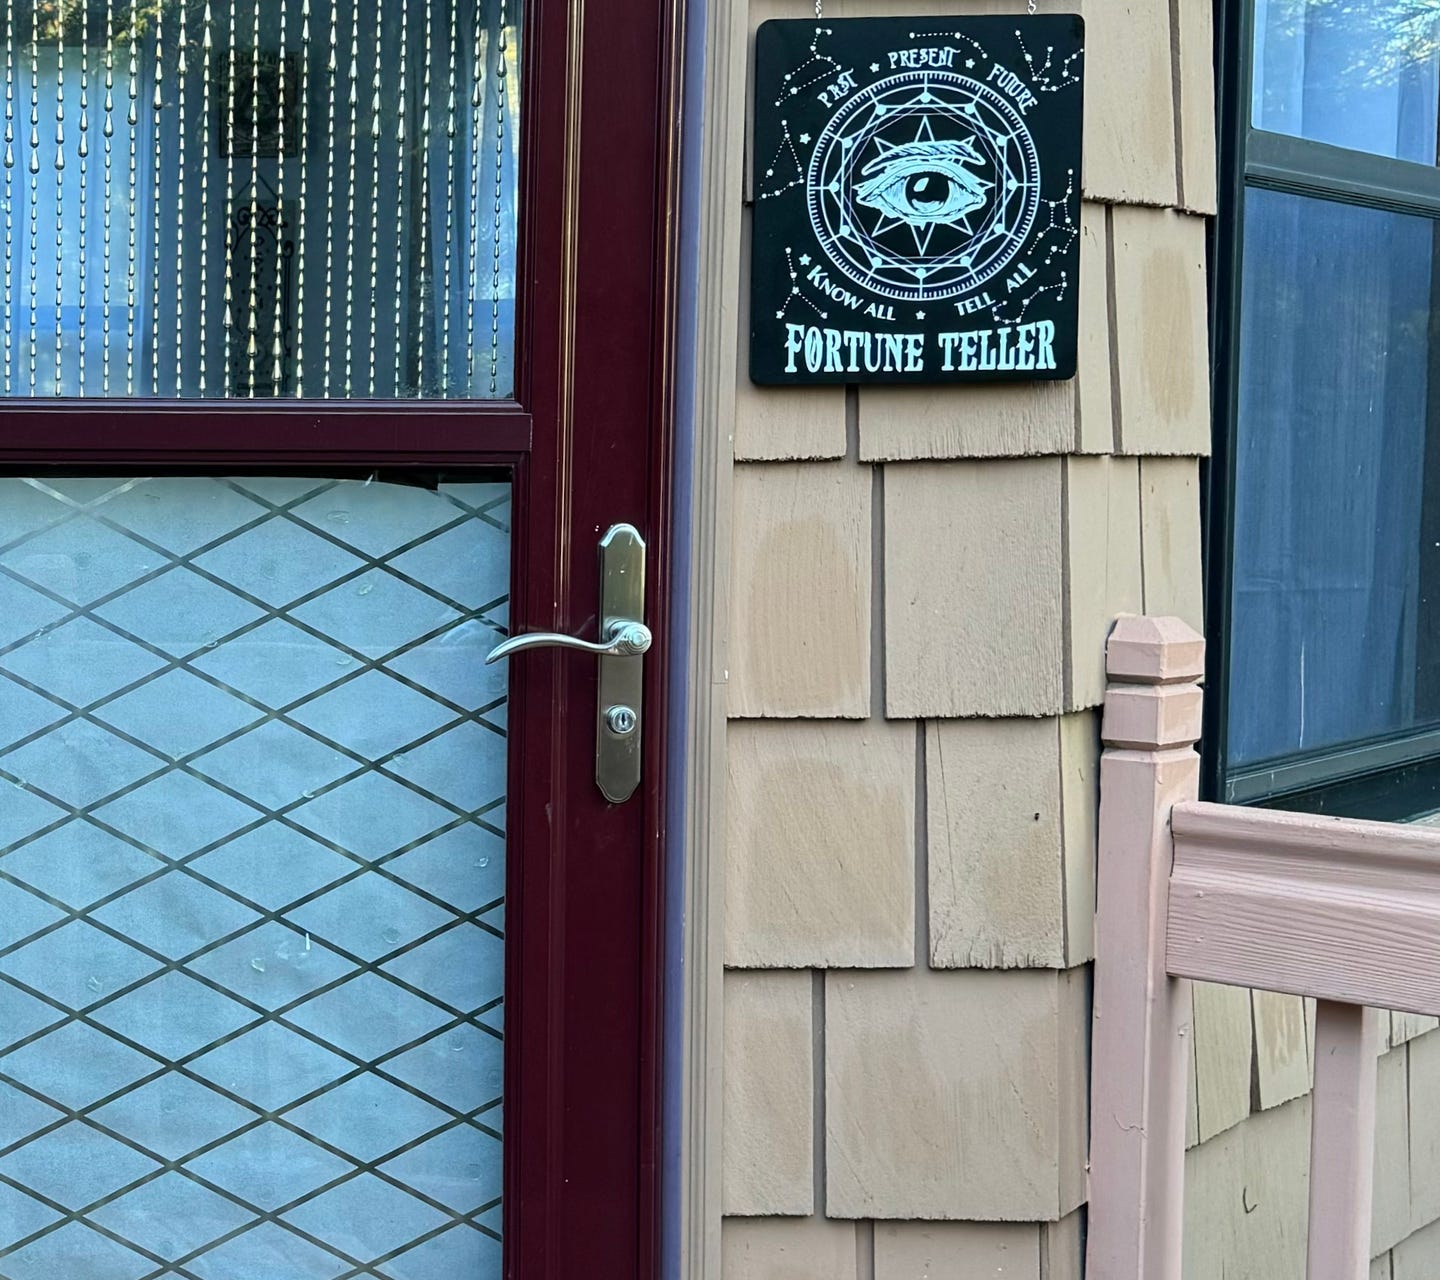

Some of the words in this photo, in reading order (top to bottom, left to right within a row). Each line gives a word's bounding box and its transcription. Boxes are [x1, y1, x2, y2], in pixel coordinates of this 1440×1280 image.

[817, 68, 859, 109] PAST
[887, 47, 961, 70] PRESENT
[986, 63, 1039, 115] FUTURE
[807, 265, 864, 311] KNOW
[863, 302, 898, 321] ALL
[954, 292, 997, 317] TELL
[1005, 262, 1038, 293] ALL
[783, 322, 925, 374] FORTUNE
[938, 319, 1058, 371] TELLER
